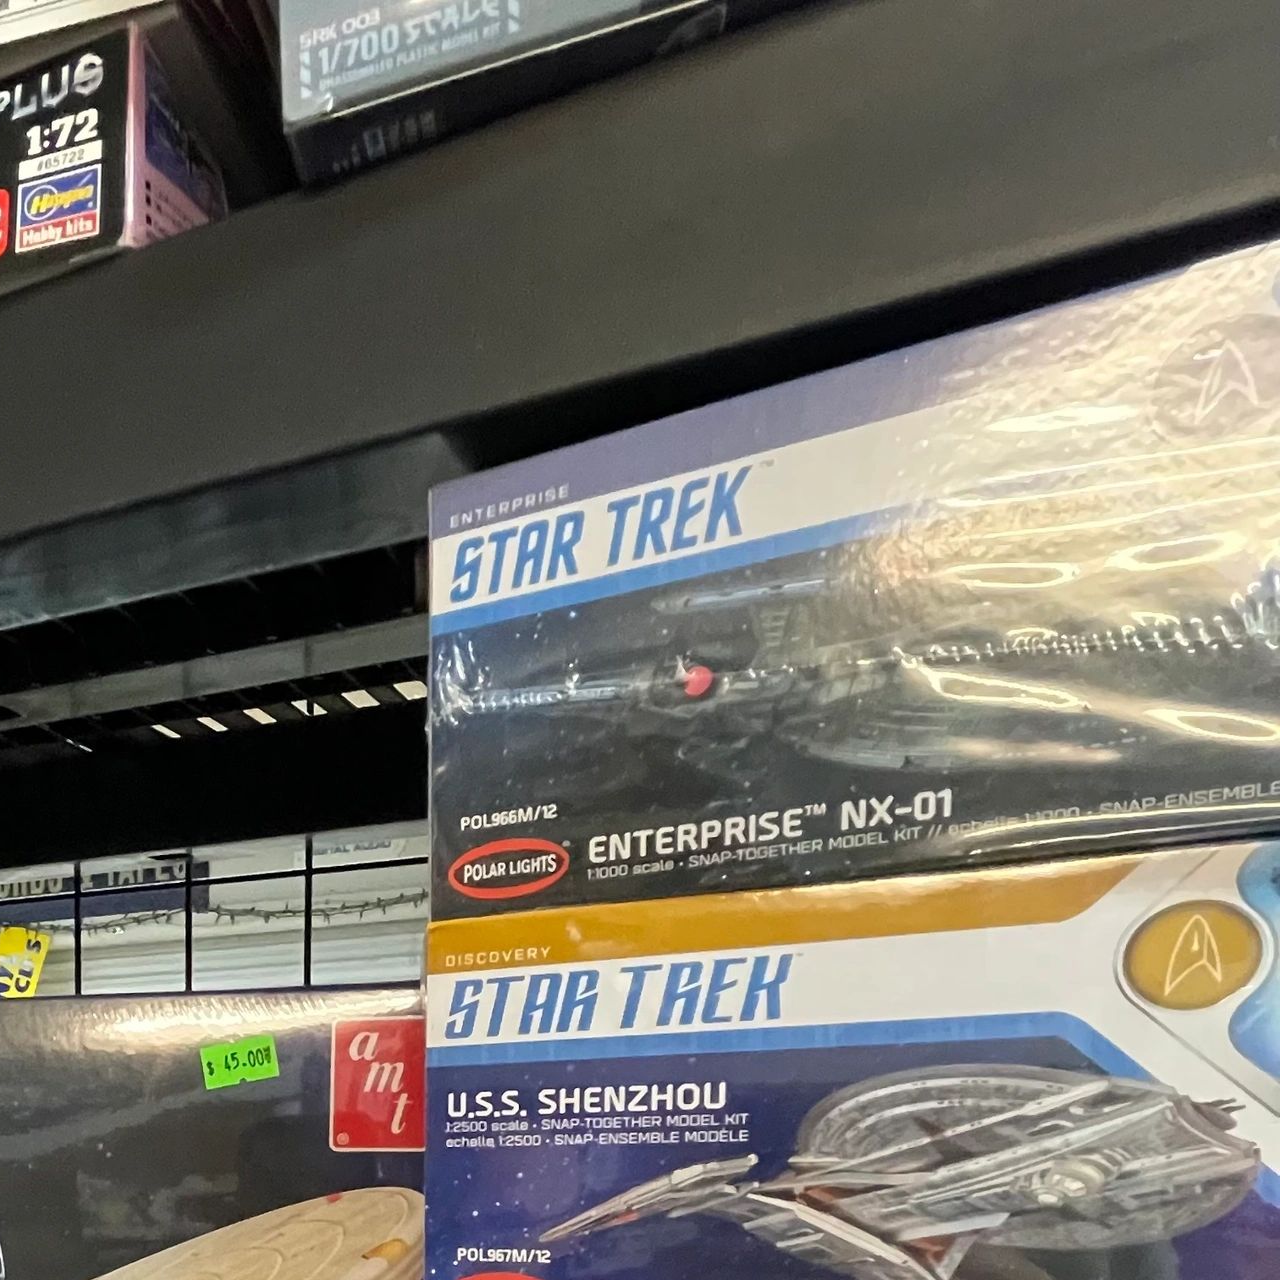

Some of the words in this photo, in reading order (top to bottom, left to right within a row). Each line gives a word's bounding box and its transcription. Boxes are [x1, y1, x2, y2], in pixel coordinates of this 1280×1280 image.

[319, 24, 400, 76] 1/700
[26, 108, 99, 155] 1:72
[449, 483, 571, 529] ENTERPRISE
[449, 509, 585, 603] STAR
[606, 463, 754, 568] TREK
[460, 803, 559, 832] POL966M/12
[840, 788, 955, 831] NX-01
[463, 856, 507, 885] POLAR
[508, 852, 558, 878] LIGHTS
[632, 858, 675, 876] scale
[687, 838, 824, 869] SNAP-TOGETHER
[827, 830, 890, 852] MODEL
[894, 825, 925, 844] KIT
[445, 946, 552, 968] DISCOVERY
[445, 968, 601, 1040] STAR
[619, 953, 794, 1030] TREK
[348, 1030, 413, 1135] amt
[447, 1090, 528, 1119] U.S.S.
[538, 1081, 727, 1116] SHENZHOU
[490, 1119, 529, 1133] scale
[541, 1115, 663, 1131] SNAP-TOGETHER
[666, 1113, 721, 1128] MODEL
[724, 1112, 749, 1126] KIT
[554, 1130, 680, 1146] SNAP-ENSEMBLE
[456, 1246, 552, 1264] POL967M/12
